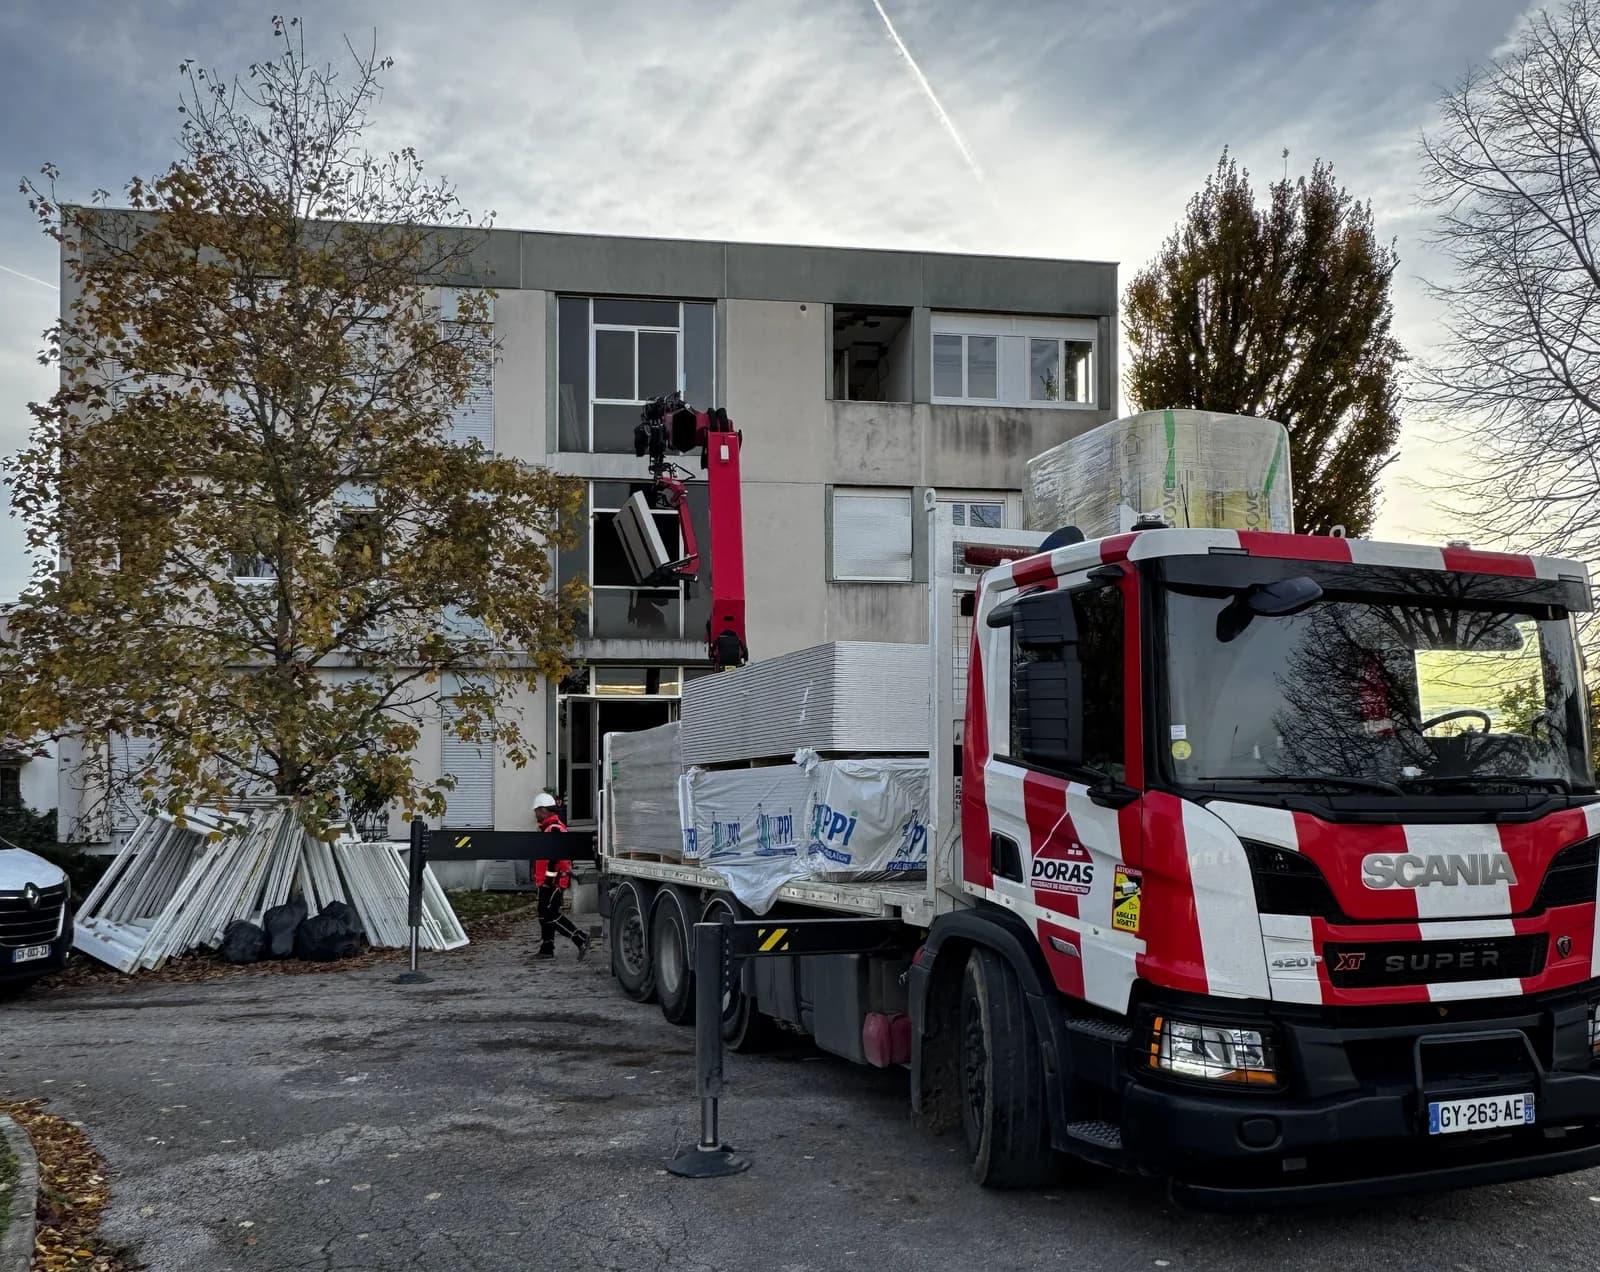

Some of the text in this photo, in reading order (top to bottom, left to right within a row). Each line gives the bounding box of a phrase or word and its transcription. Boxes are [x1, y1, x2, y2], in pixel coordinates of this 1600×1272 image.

[1032, 860, 1094, 884] DORAS
[1363, 853, 1517, 888] SCANIA
[1334, 950, 1499, 972] XT SUPER
